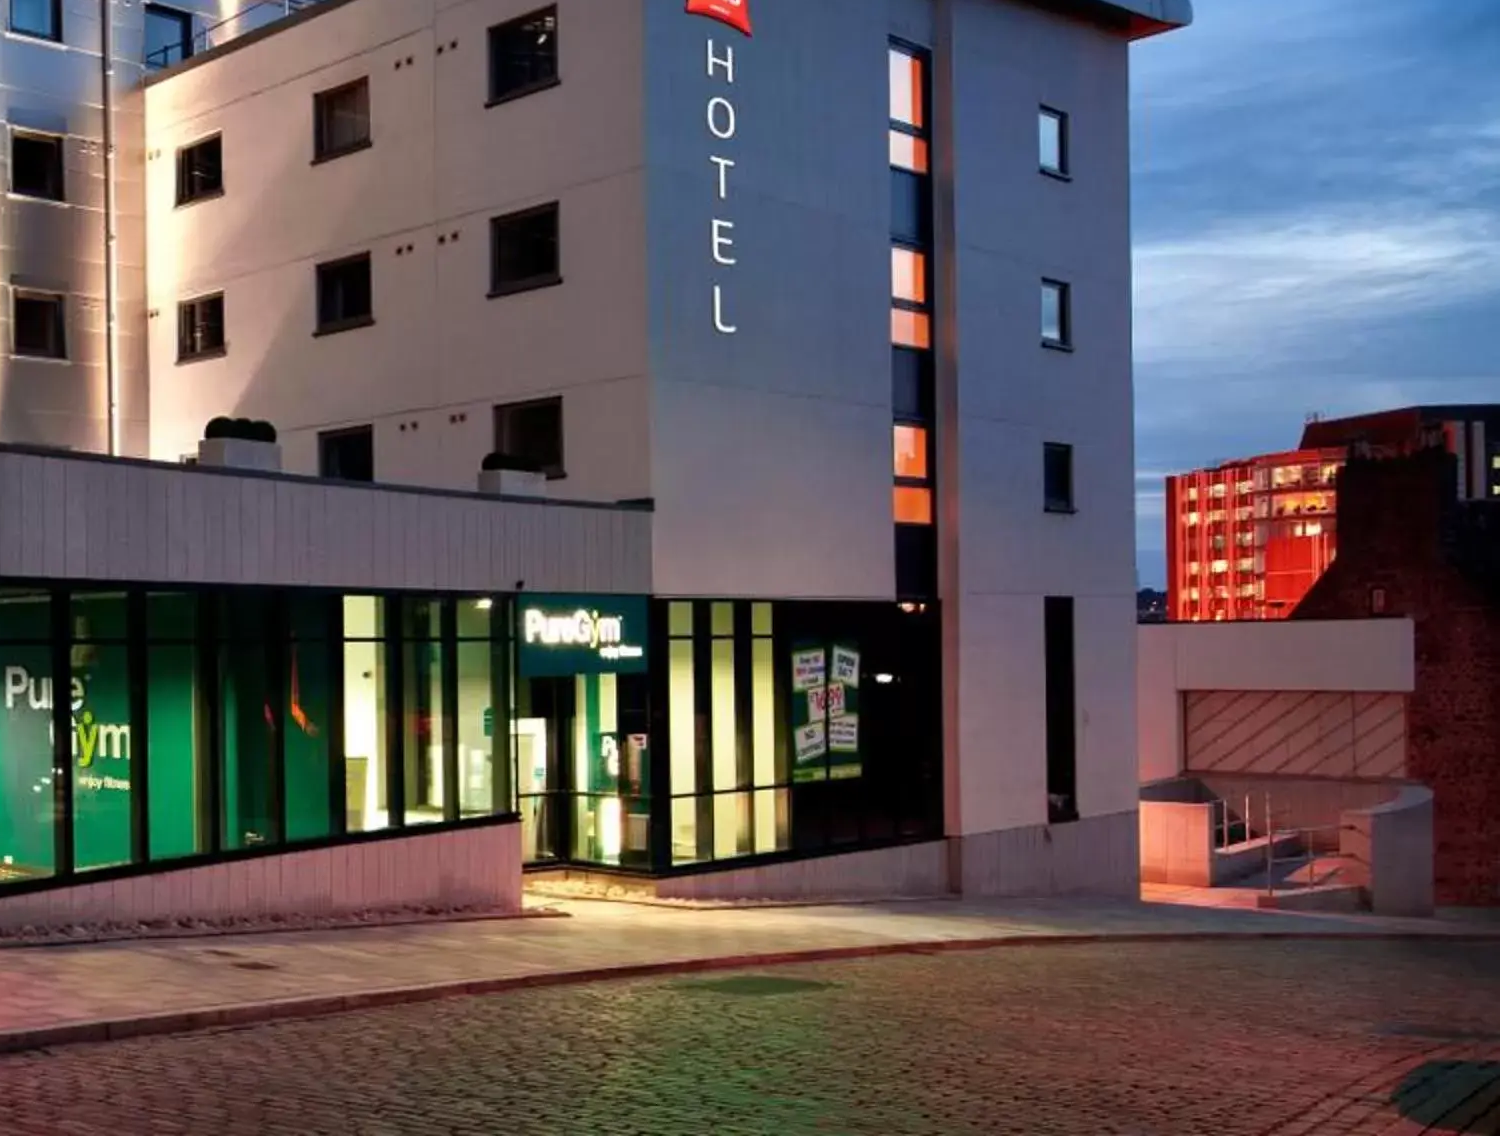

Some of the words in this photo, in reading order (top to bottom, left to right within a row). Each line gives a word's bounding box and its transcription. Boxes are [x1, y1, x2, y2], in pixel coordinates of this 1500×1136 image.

[707, 38, 737, 333] HOTEL
[525, 608, 621, 649] PureGym
[5, 665, 85, 711] Pue
